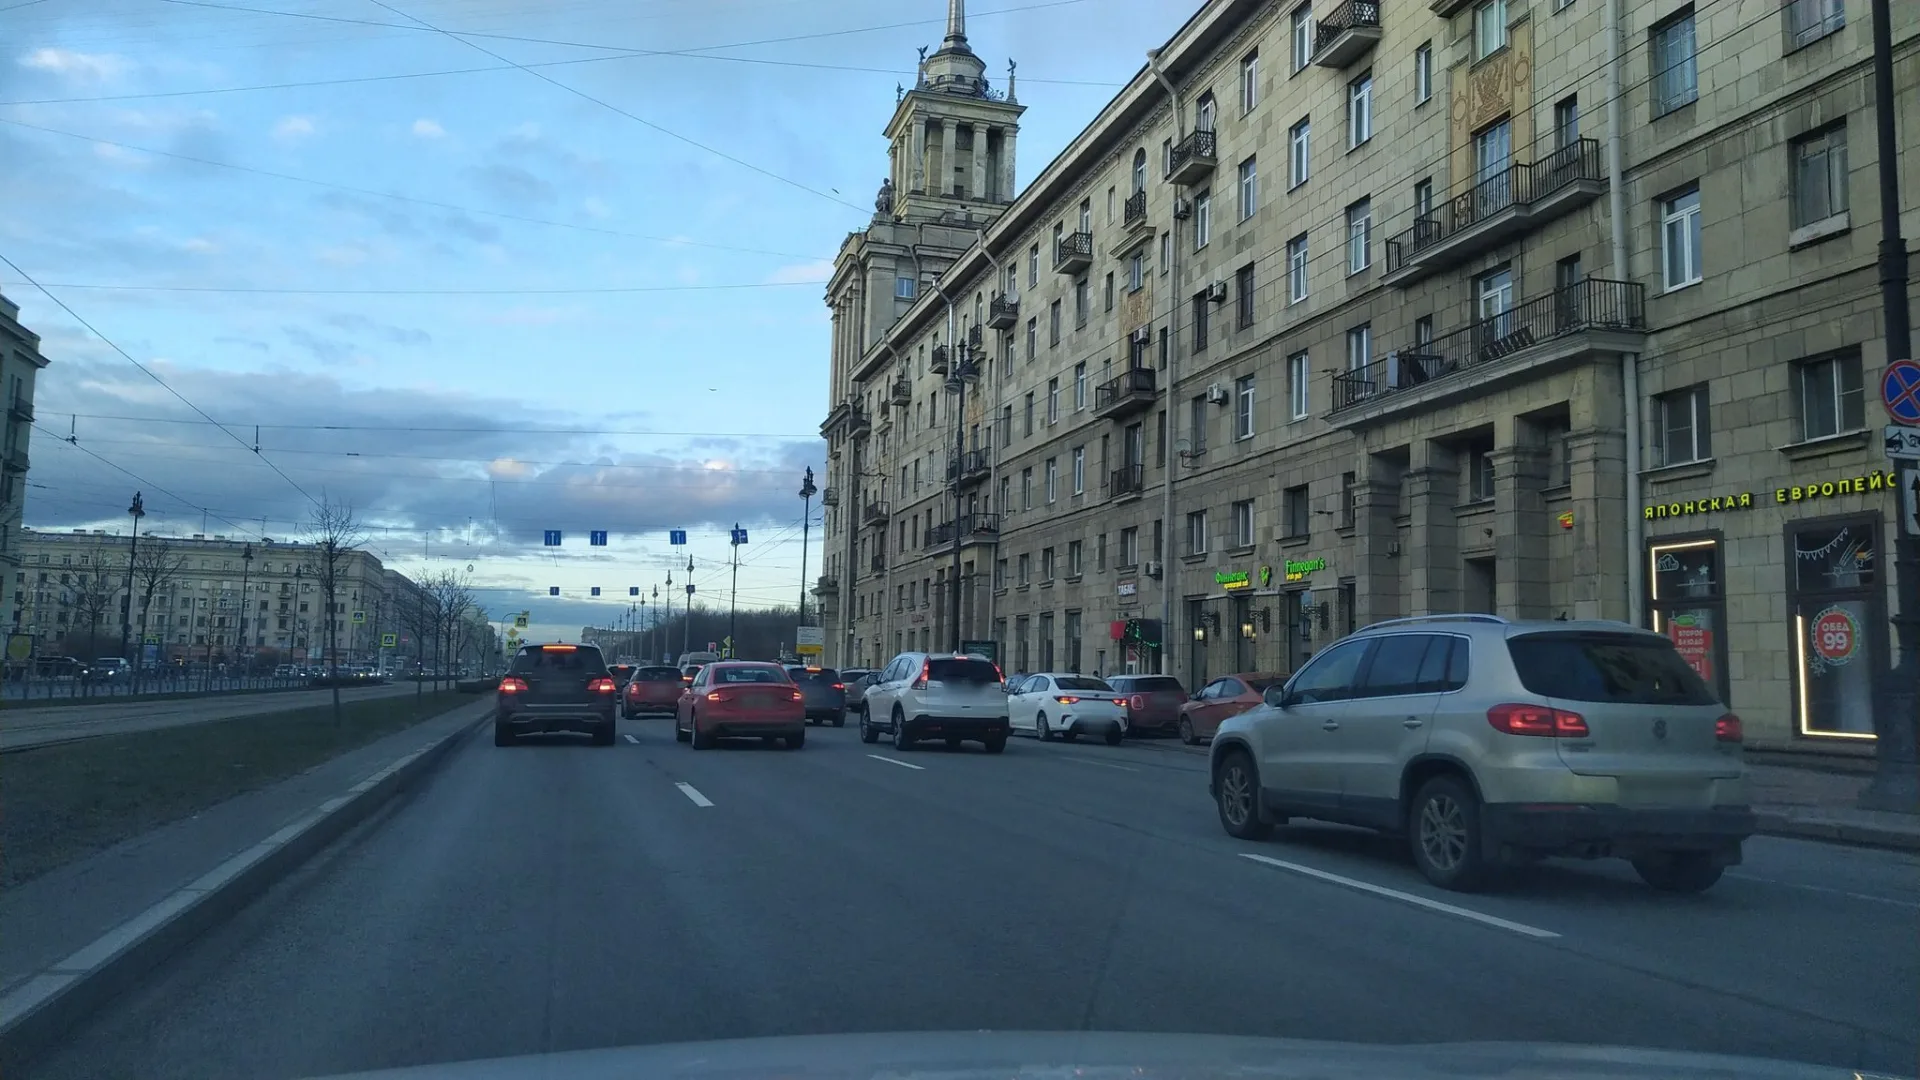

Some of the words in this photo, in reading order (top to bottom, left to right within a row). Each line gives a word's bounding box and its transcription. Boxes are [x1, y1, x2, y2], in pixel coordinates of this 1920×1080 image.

[1645, 492, 1751, 519] ЯПОНСКАЯ
[1822, 622, 1850, 632] ОБЕД
[1823, 632, 1848, 650] 99
